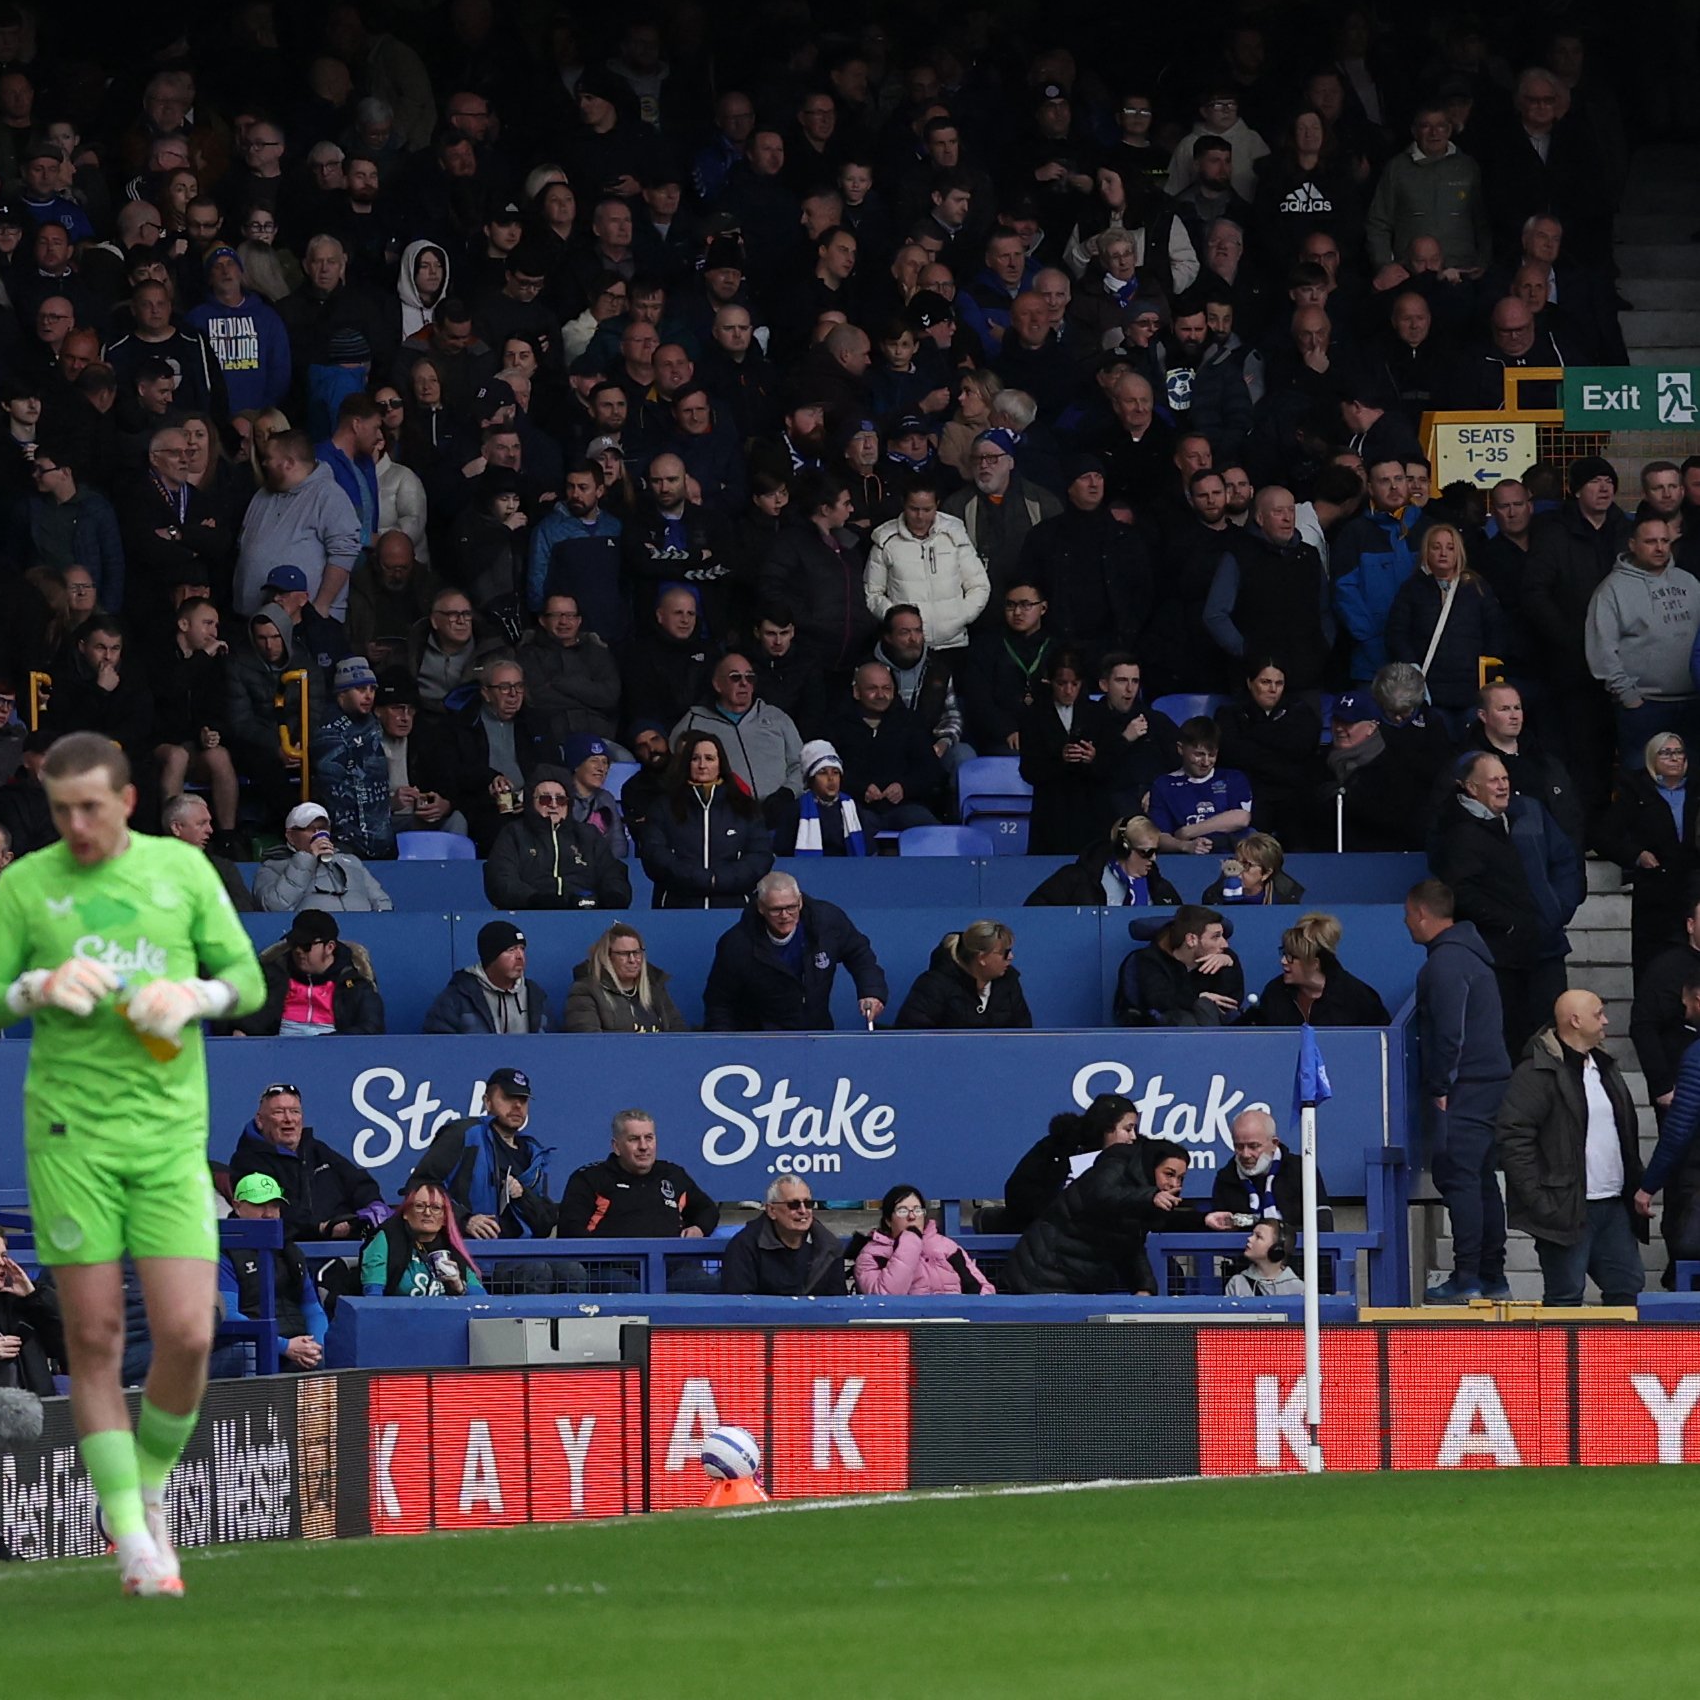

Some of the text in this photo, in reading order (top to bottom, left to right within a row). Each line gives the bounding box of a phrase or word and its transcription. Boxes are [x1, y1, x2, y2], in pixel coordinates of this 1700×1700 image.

[1279, 198, 1333, 213] adidas
[1582, 384, 1641, 411] Exit
[1458, 428, 1515, 444] SEATS
[1466, 448, 1509, 463] 1-35
[702, 1064, 897, 1167] Stake
[766, 1152, 842, 1174] .com
[213, 1403, 291, 1543] Website
